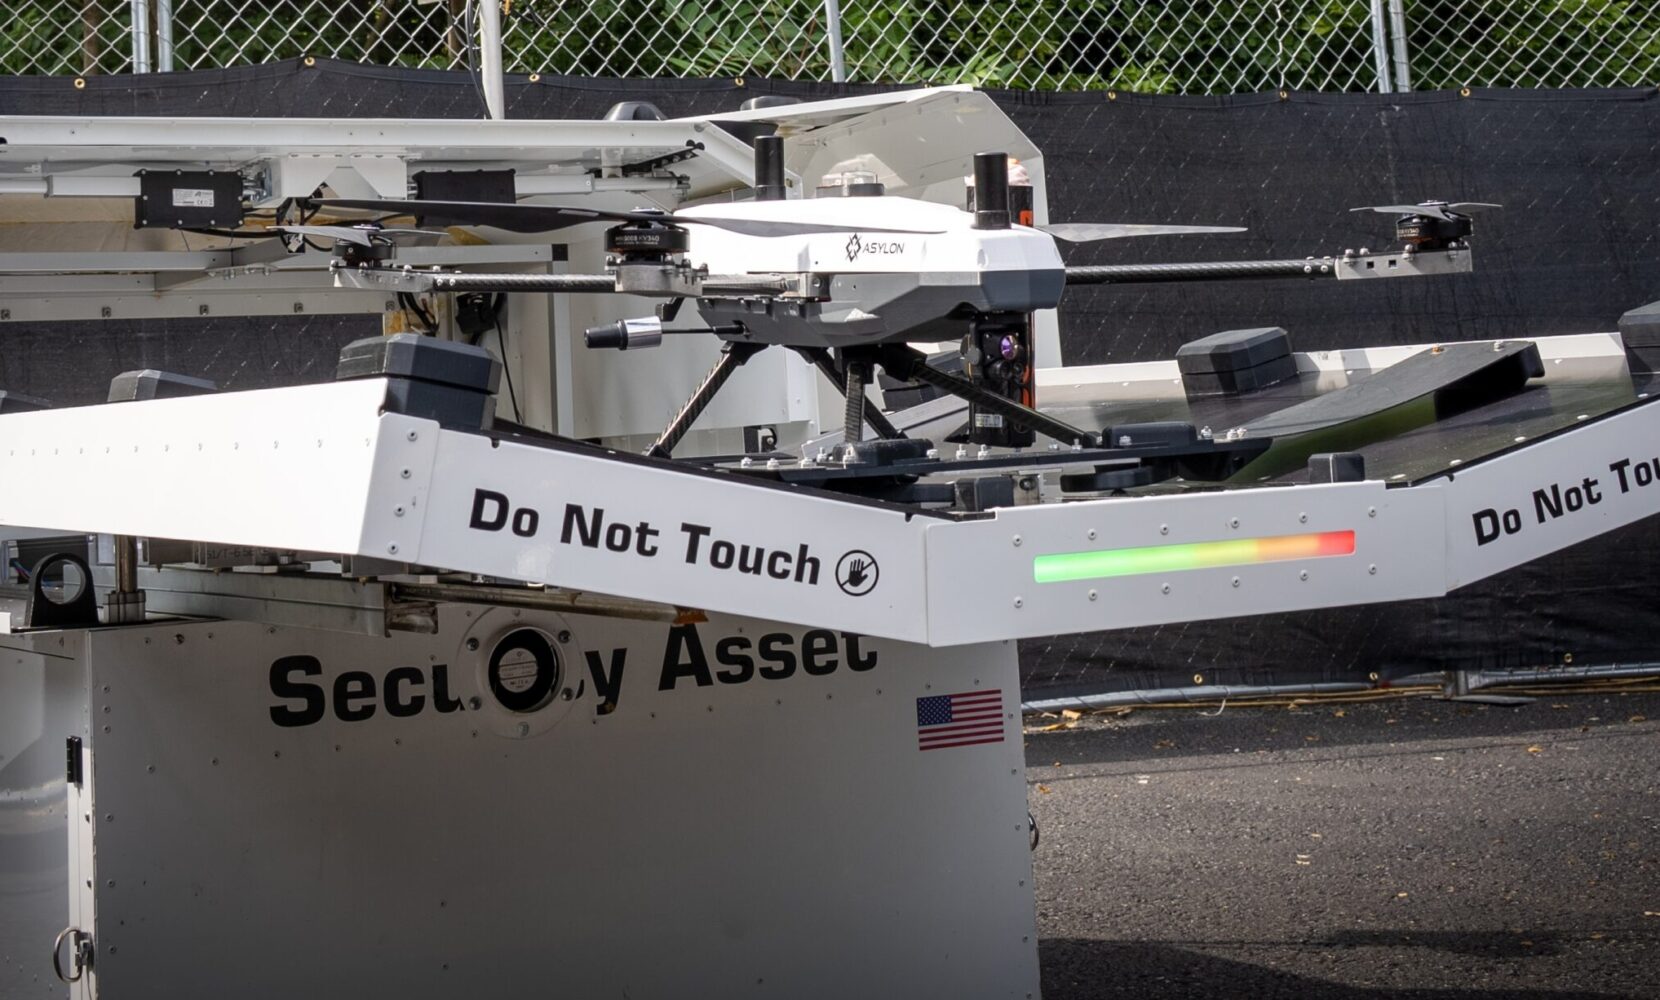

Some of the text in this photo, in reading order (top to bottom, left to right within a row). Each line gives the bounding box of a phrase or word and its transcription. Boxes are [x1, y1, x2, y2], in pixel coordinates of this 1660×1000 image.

[863, 242, 905, 254] ASYLON
[469, 487, 821, 586] Do Not Touch
[1472, 508, 1522, 547] Do
[1532, 478, 1603, 524] Not
[268, 647, 628, 728] Secuy
[658, 623, 878, 692] Asset
